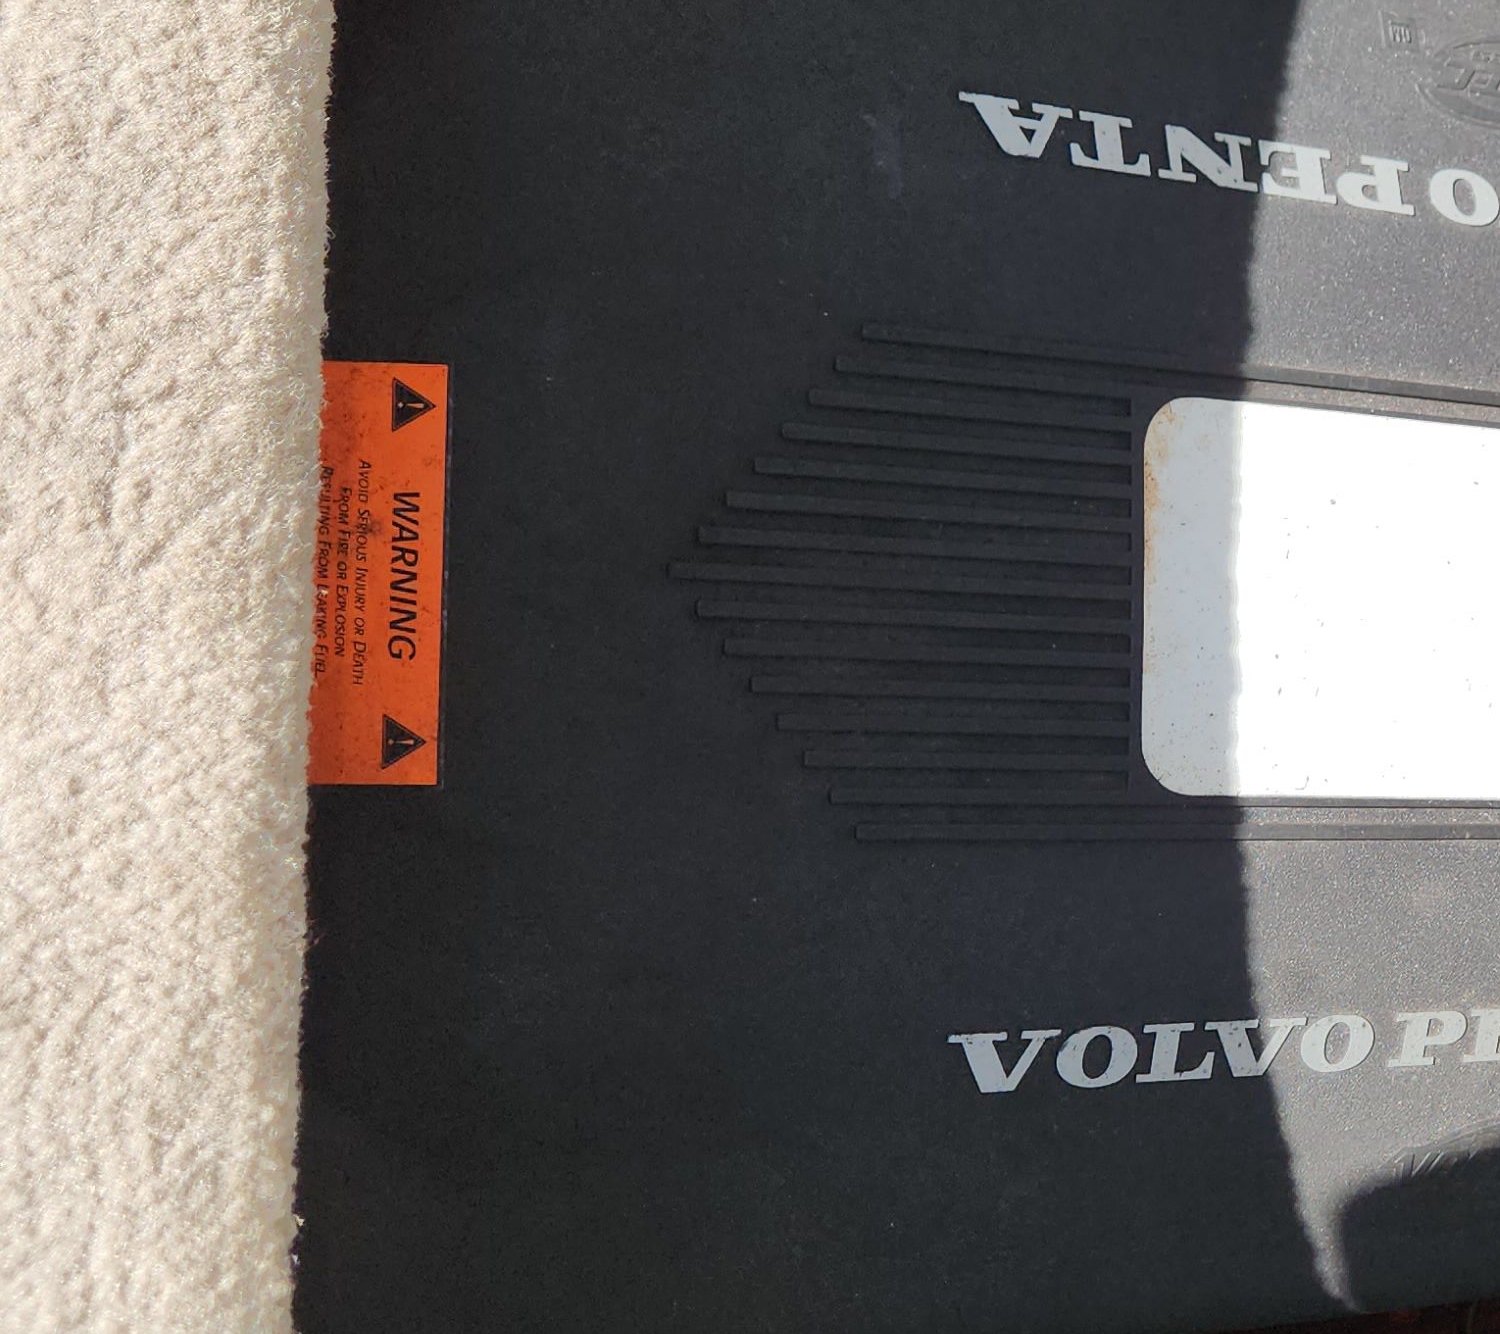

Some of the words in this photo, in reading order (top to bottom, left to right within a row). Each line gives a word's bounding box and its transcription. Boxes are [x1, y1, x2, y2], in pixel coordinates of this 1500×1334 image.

[959, 91, 1415, 216] PENTA
[358, 459, 371, 503] AVOID
[338, 487, 352, 525] FROM
[337, 529, 350, 556] FIRE
[356, 508, 370, 562] SERIOUS
[317, 540, 331, 578] FROM
[336, 561, 347, 580] OR
[388, 492, 420, 661] WARNING
[354, 567, 368, 612] INJURY
[335, 584, 348, 657] EXPLOSION
[354, 617, 365, 636] OR
[352, 641, 366, 685] DEATH
[947, 1014, 1374, 1094] VOLVO
